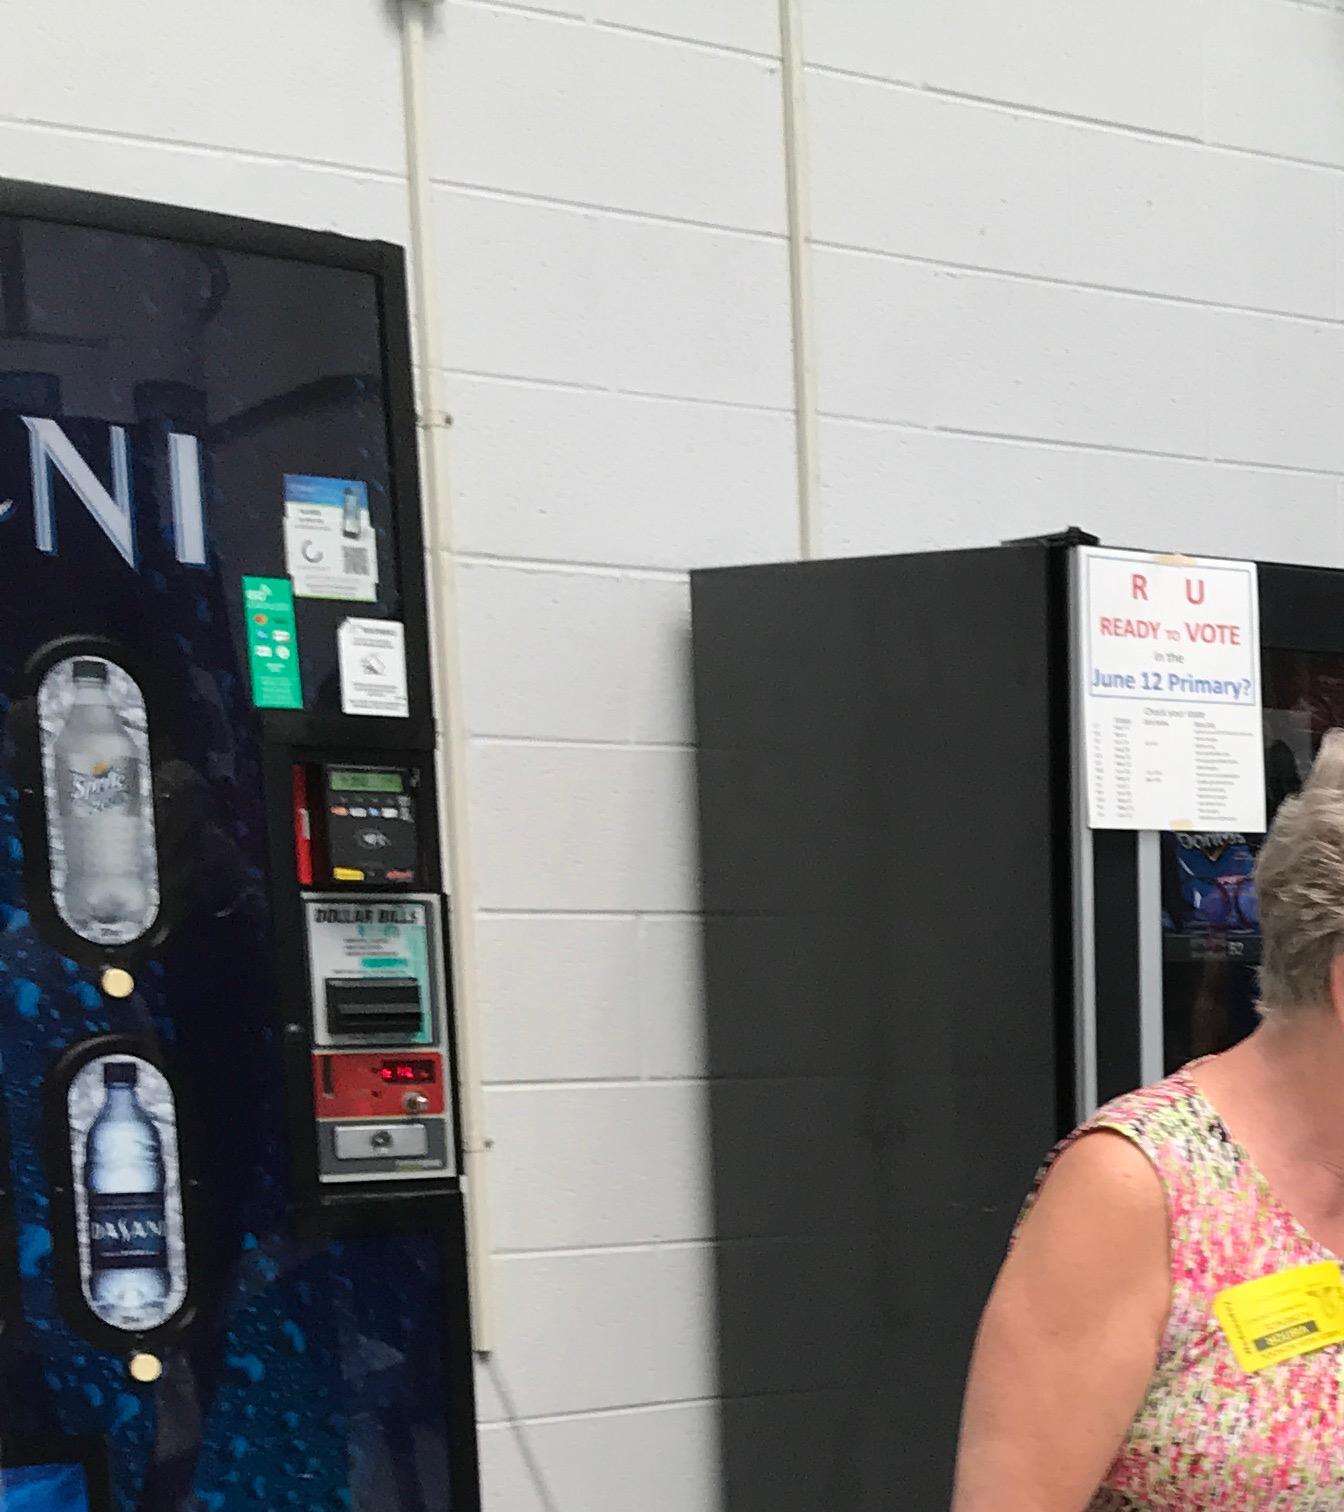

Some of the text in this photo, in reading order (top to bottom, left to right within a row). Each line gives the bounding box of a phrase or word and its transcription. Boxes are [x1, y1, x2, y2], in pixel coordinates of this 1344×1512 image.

[0, 414, 209, 576] NI
[1130, 573, 1206, 605] R U
[1100, 615, 1161, 640] READY
[1184, 621, 1241, 646] VOTE
[1093, 668, 1252, 700] June 12 Primary?
